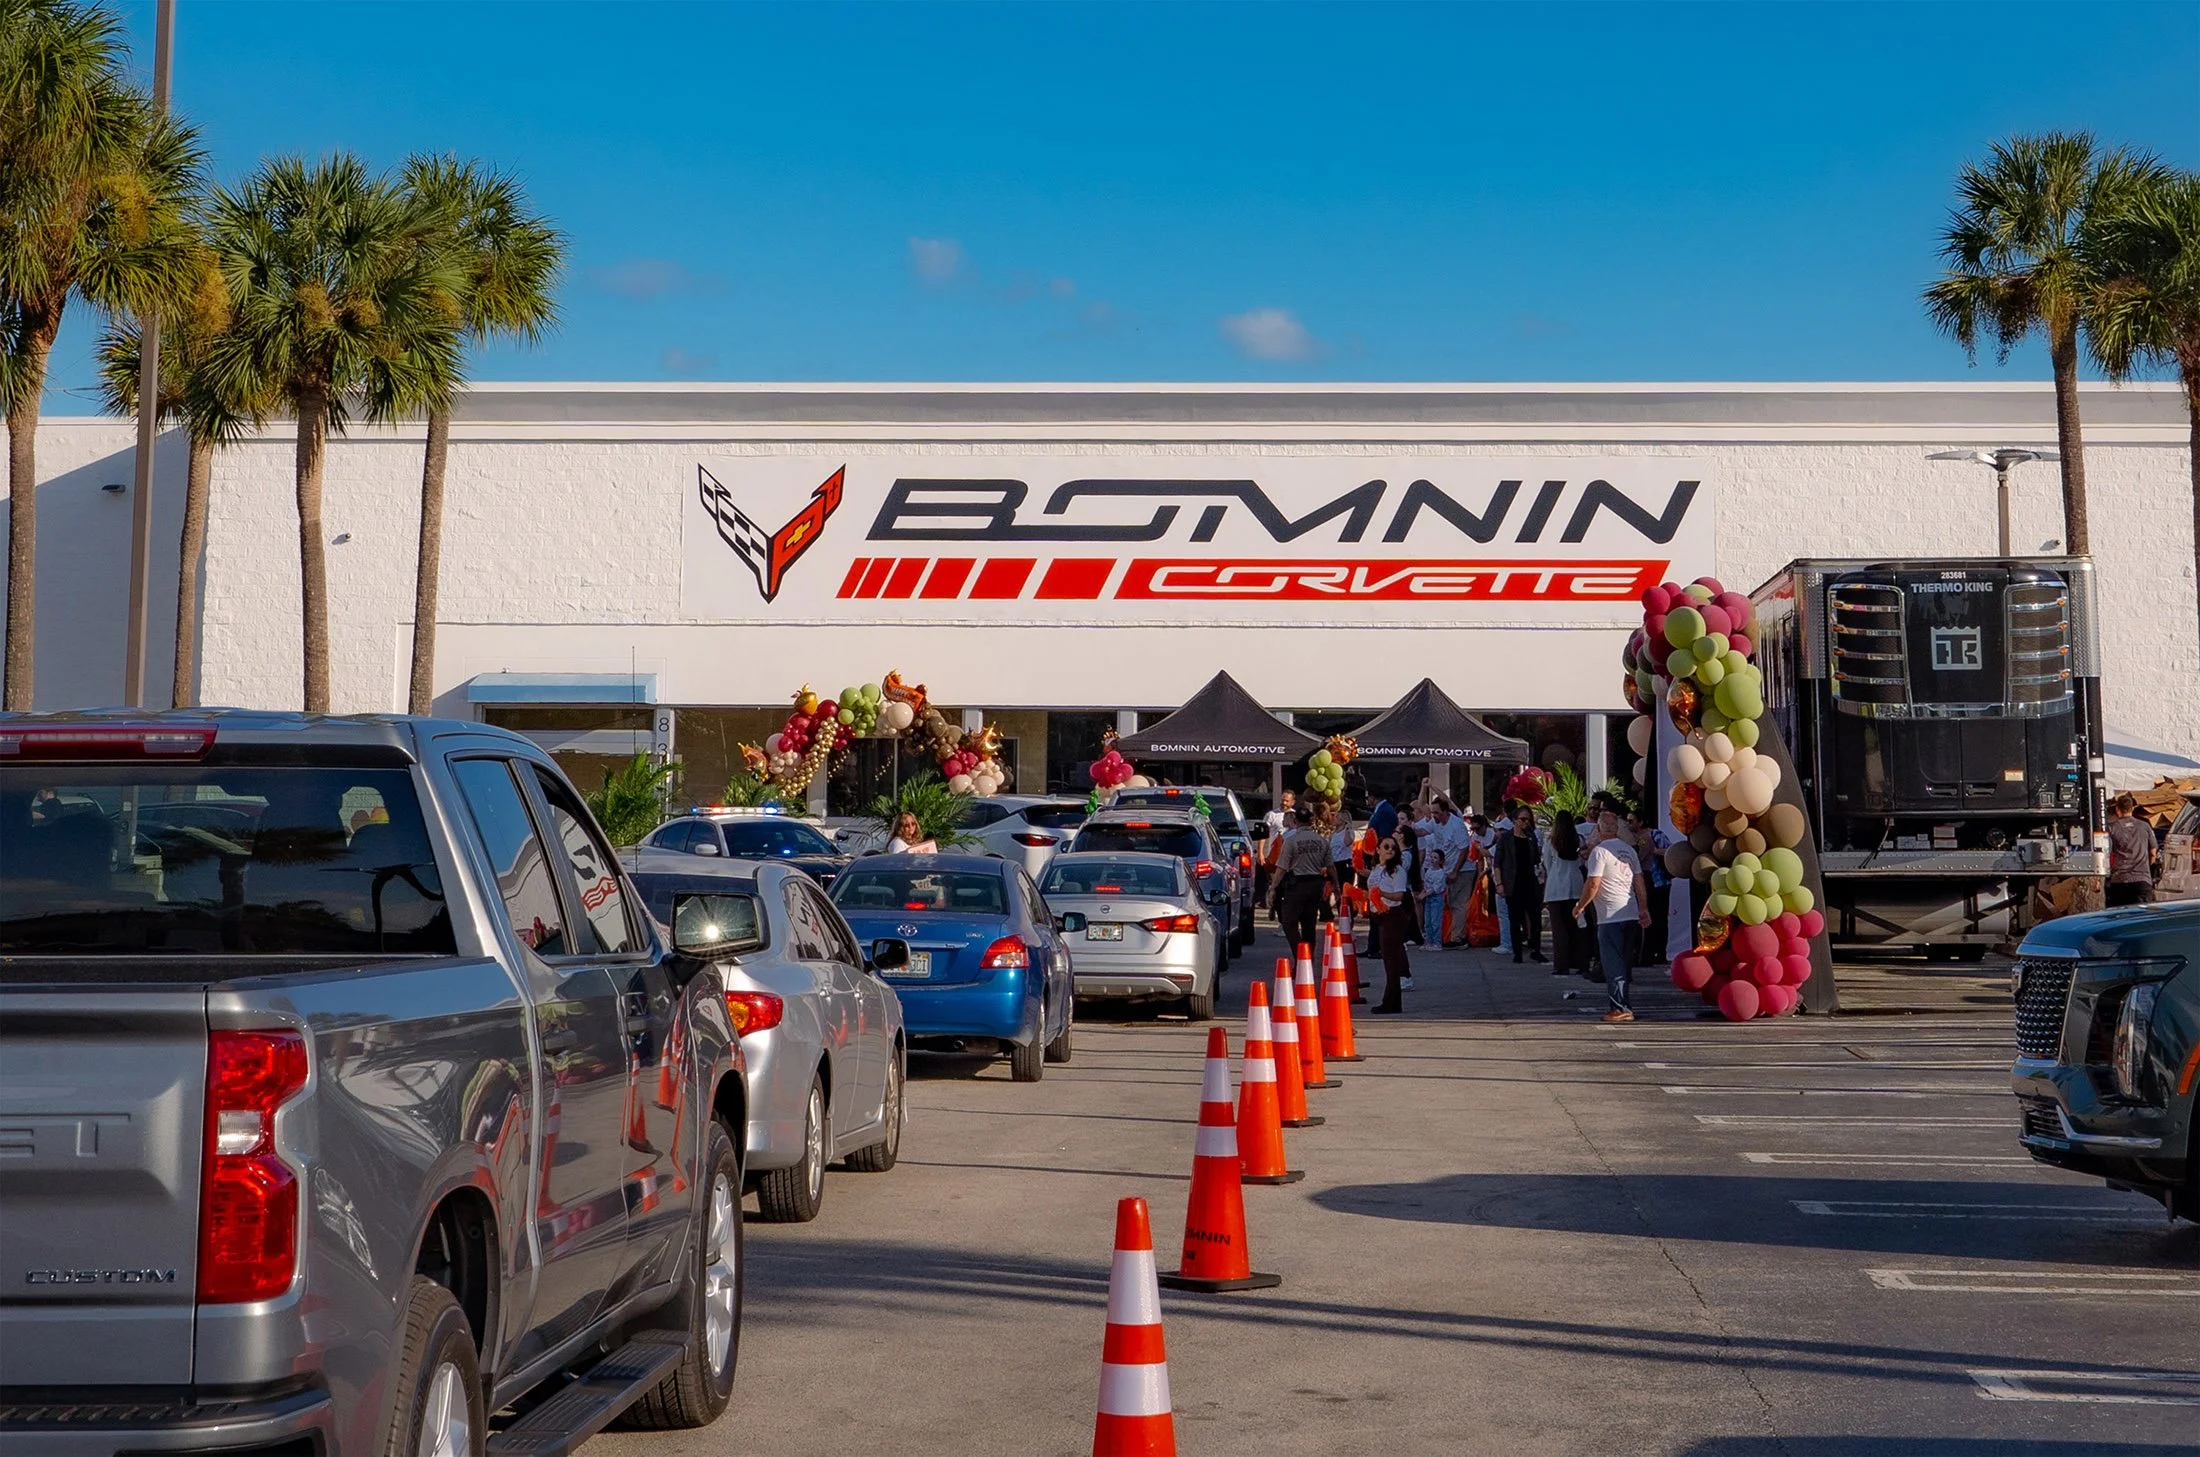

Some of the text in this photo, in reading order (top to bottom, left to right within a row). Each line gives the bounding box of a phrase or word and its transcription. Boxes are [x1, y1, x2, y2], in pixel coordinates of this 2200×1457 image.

[864, 478, 1701, 543] BOMNIN
[1147, 564, 1646, 596] CORVETTE
[1910, 582, 1993, 593] THERMO KING
[1150, 744, 1286, 754] BOMNIN AUTOMOTIVE
[1357, 747, 1492, 757] BOMNIN AUTOMOTIVE
[1185, 1227, 1231, 1245] MNIN
[26, 1268, 176, 1284] CUSTOM
